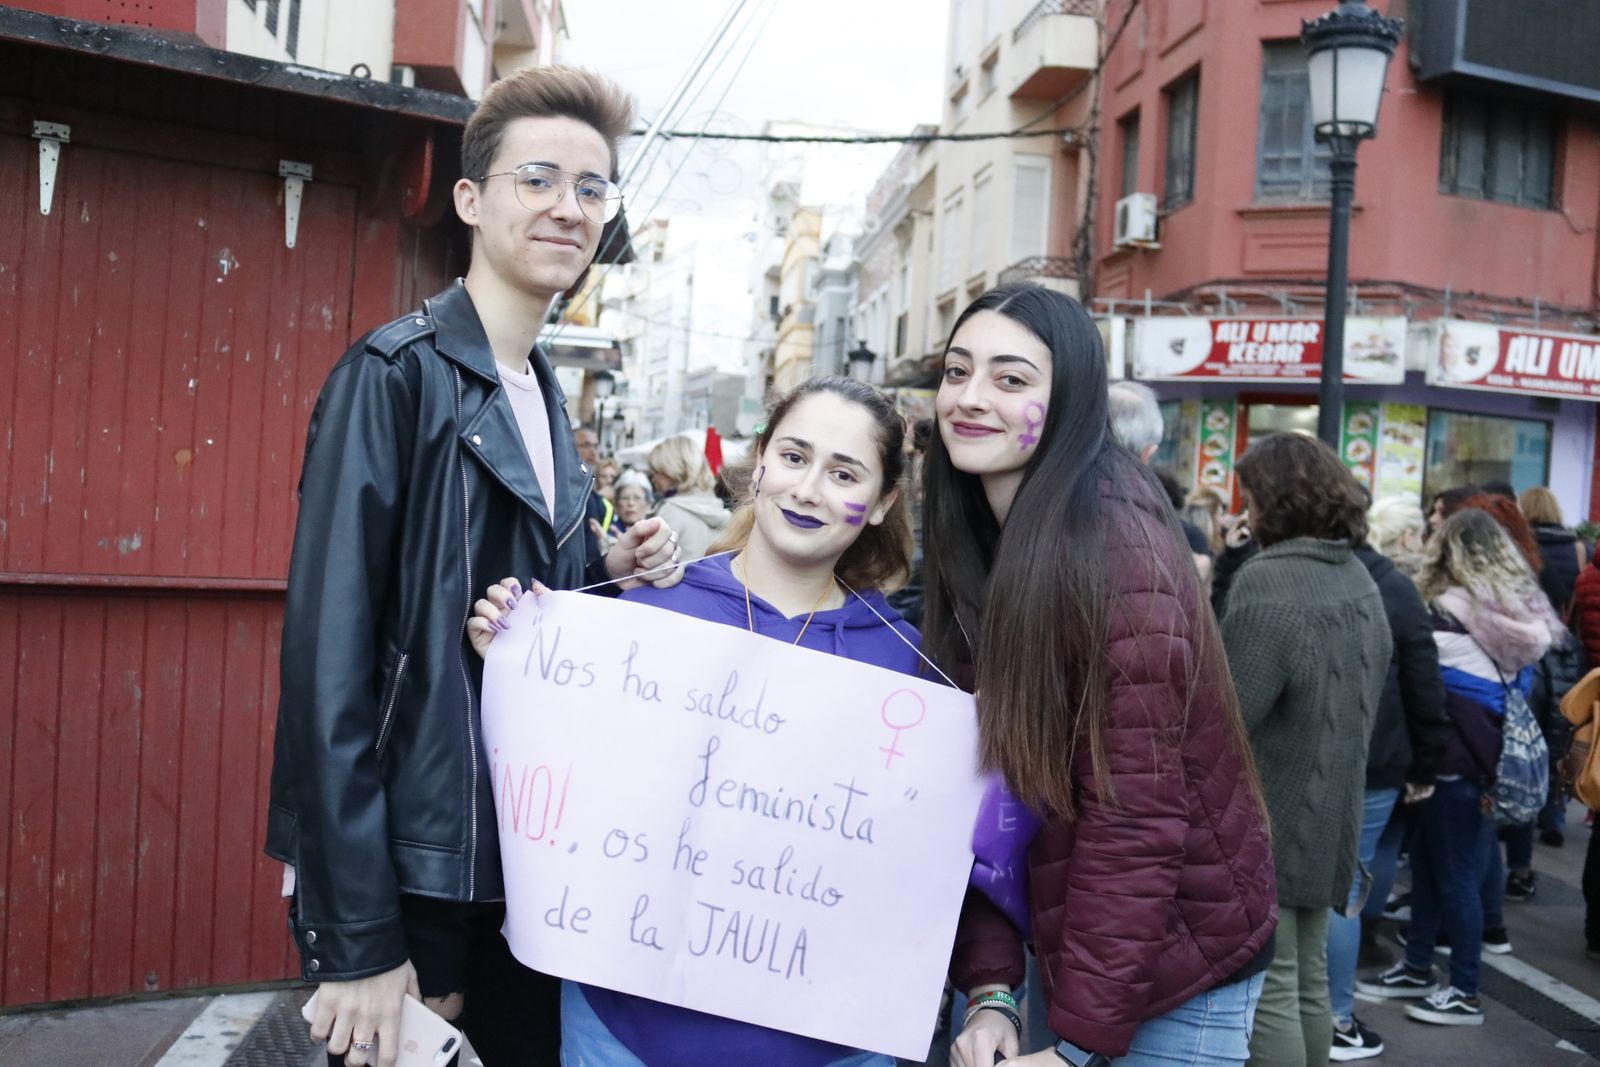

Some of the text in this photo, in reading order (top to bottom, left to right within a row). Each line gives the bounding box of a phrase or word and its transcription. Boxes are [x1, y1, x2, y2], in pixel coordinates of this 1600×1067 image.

[1215, 321, 1320, 344] ALI UMAR
[1504, 335, 1554, 376] ALI
[621, 639, 662, 702] ha
[684, 669, 787, 734] salido
[603, 827, 649, 863] os
[673, 816, 709, 876] he
[731, 845, 844, 907] salido
[544, 885, 592, 934] de
[629, 894, 664, 951] la
